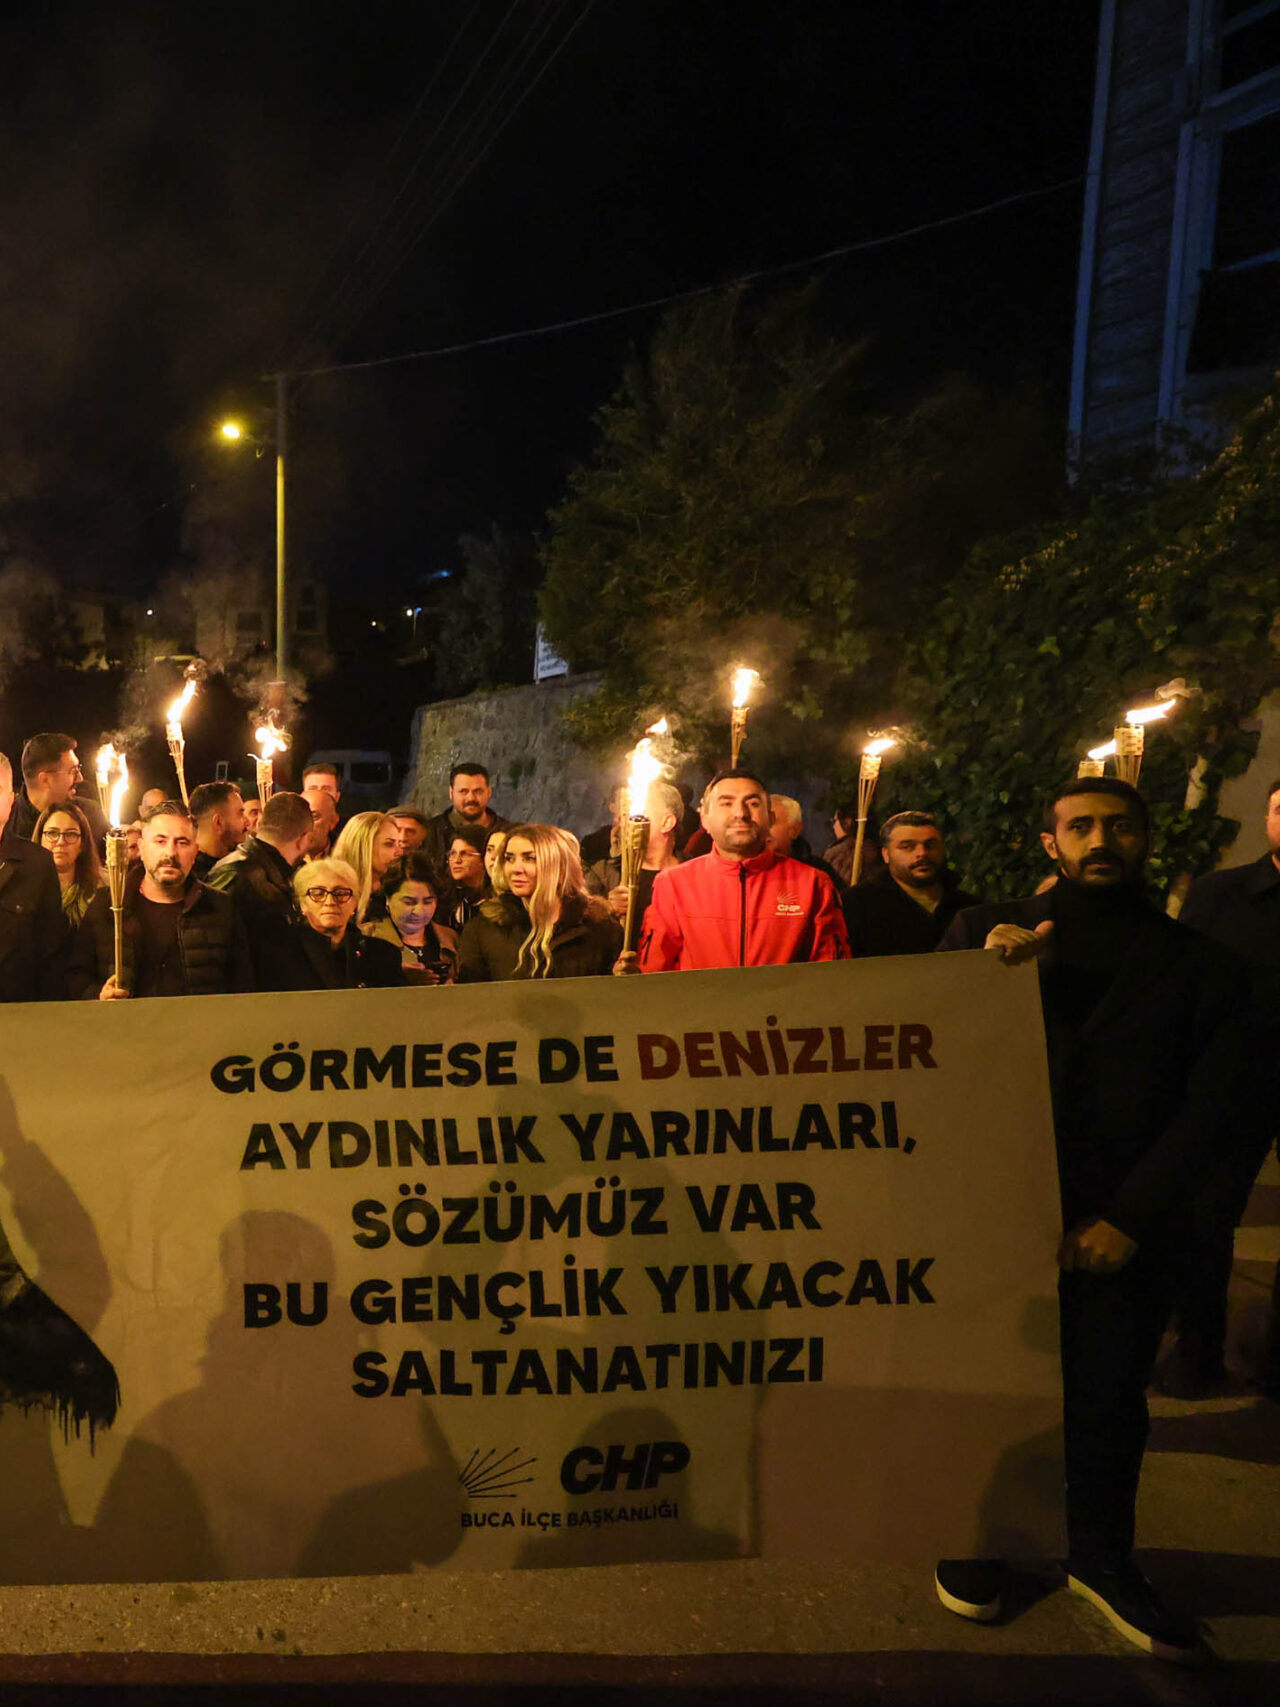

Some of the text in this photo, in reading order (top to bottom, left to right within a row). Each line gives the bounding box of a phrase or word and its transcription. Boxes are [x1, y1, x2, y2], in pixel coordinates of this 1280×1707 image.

[210, 1015, 939, 1095] GÖRMESE DE DENİZLER
[240, 1100, 918, 1171] AYDINLIK YARINLARI,
[351, 1176, 823, 1250] SÖZÜMÜZ VAR
[243, 1253, 937, 1336] BU GENÇLİK YIKACAK
[351, 1336, 824, 1399] SALTANATINIZI
[560, 1441, 691, 1496] CHP
[460, 1511, 516, 1529] BUCA
[520, 1507, 562, 1532] İLÇE
